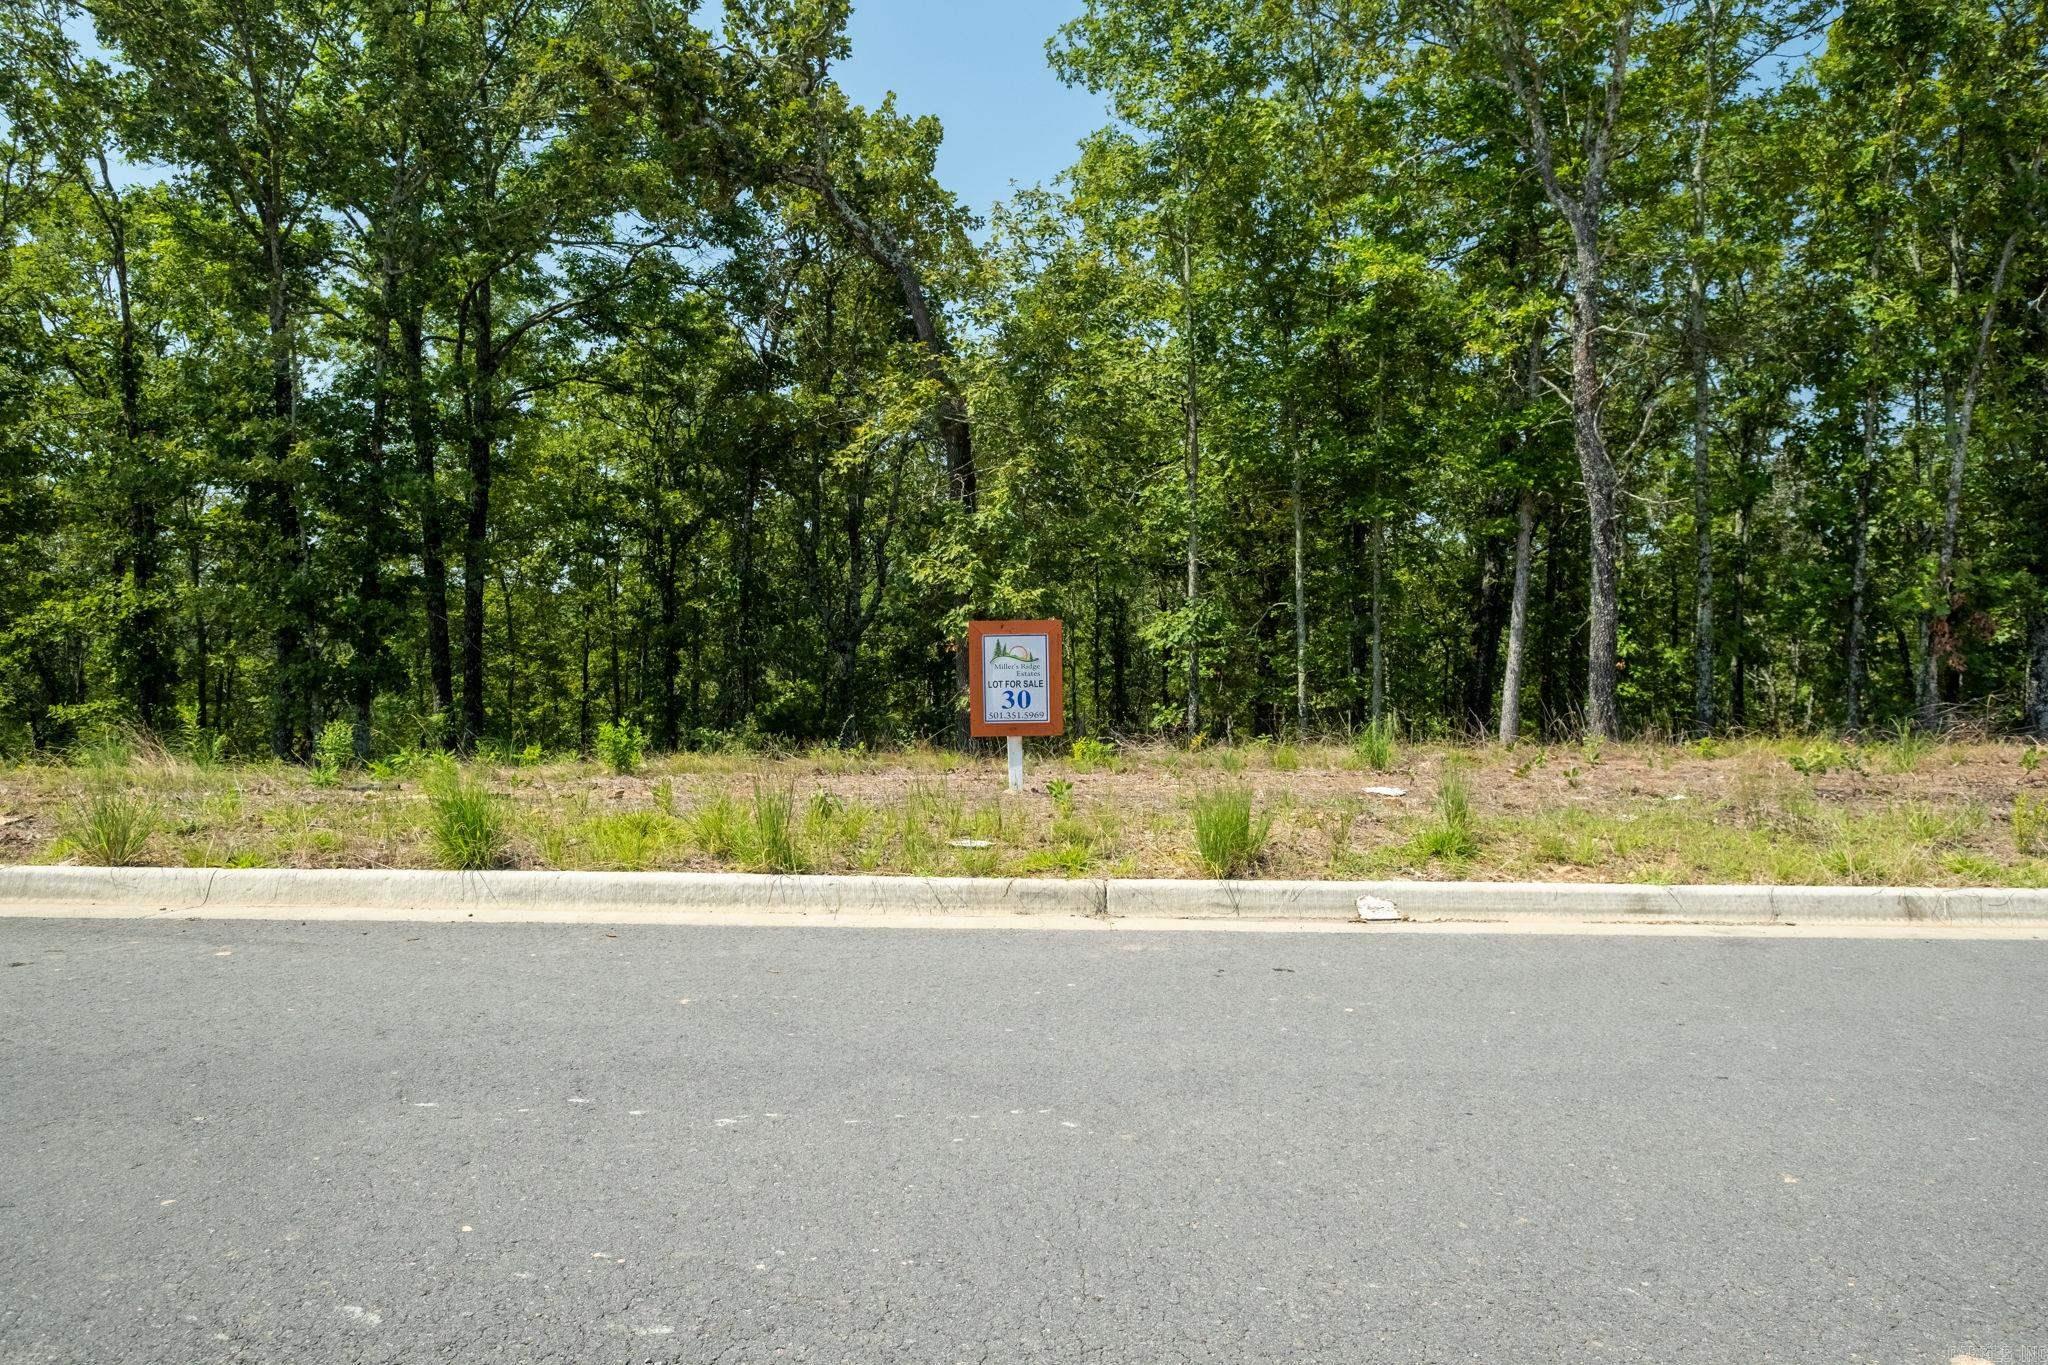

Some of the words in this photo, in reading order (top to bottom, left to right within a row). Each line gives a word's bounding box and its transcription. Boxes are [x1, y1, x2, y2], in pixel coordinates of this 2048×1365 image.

[1020, 663, 1041, 671] Ridge
[987, 680, 1004, 689] LOT
[1005, 680, 1021, 689] FOR
[1023, 679, 1044, 688] SALE
[1001, 689, 1032, 710] 30
[988, 711, 1045, 720] 501.351.5969
